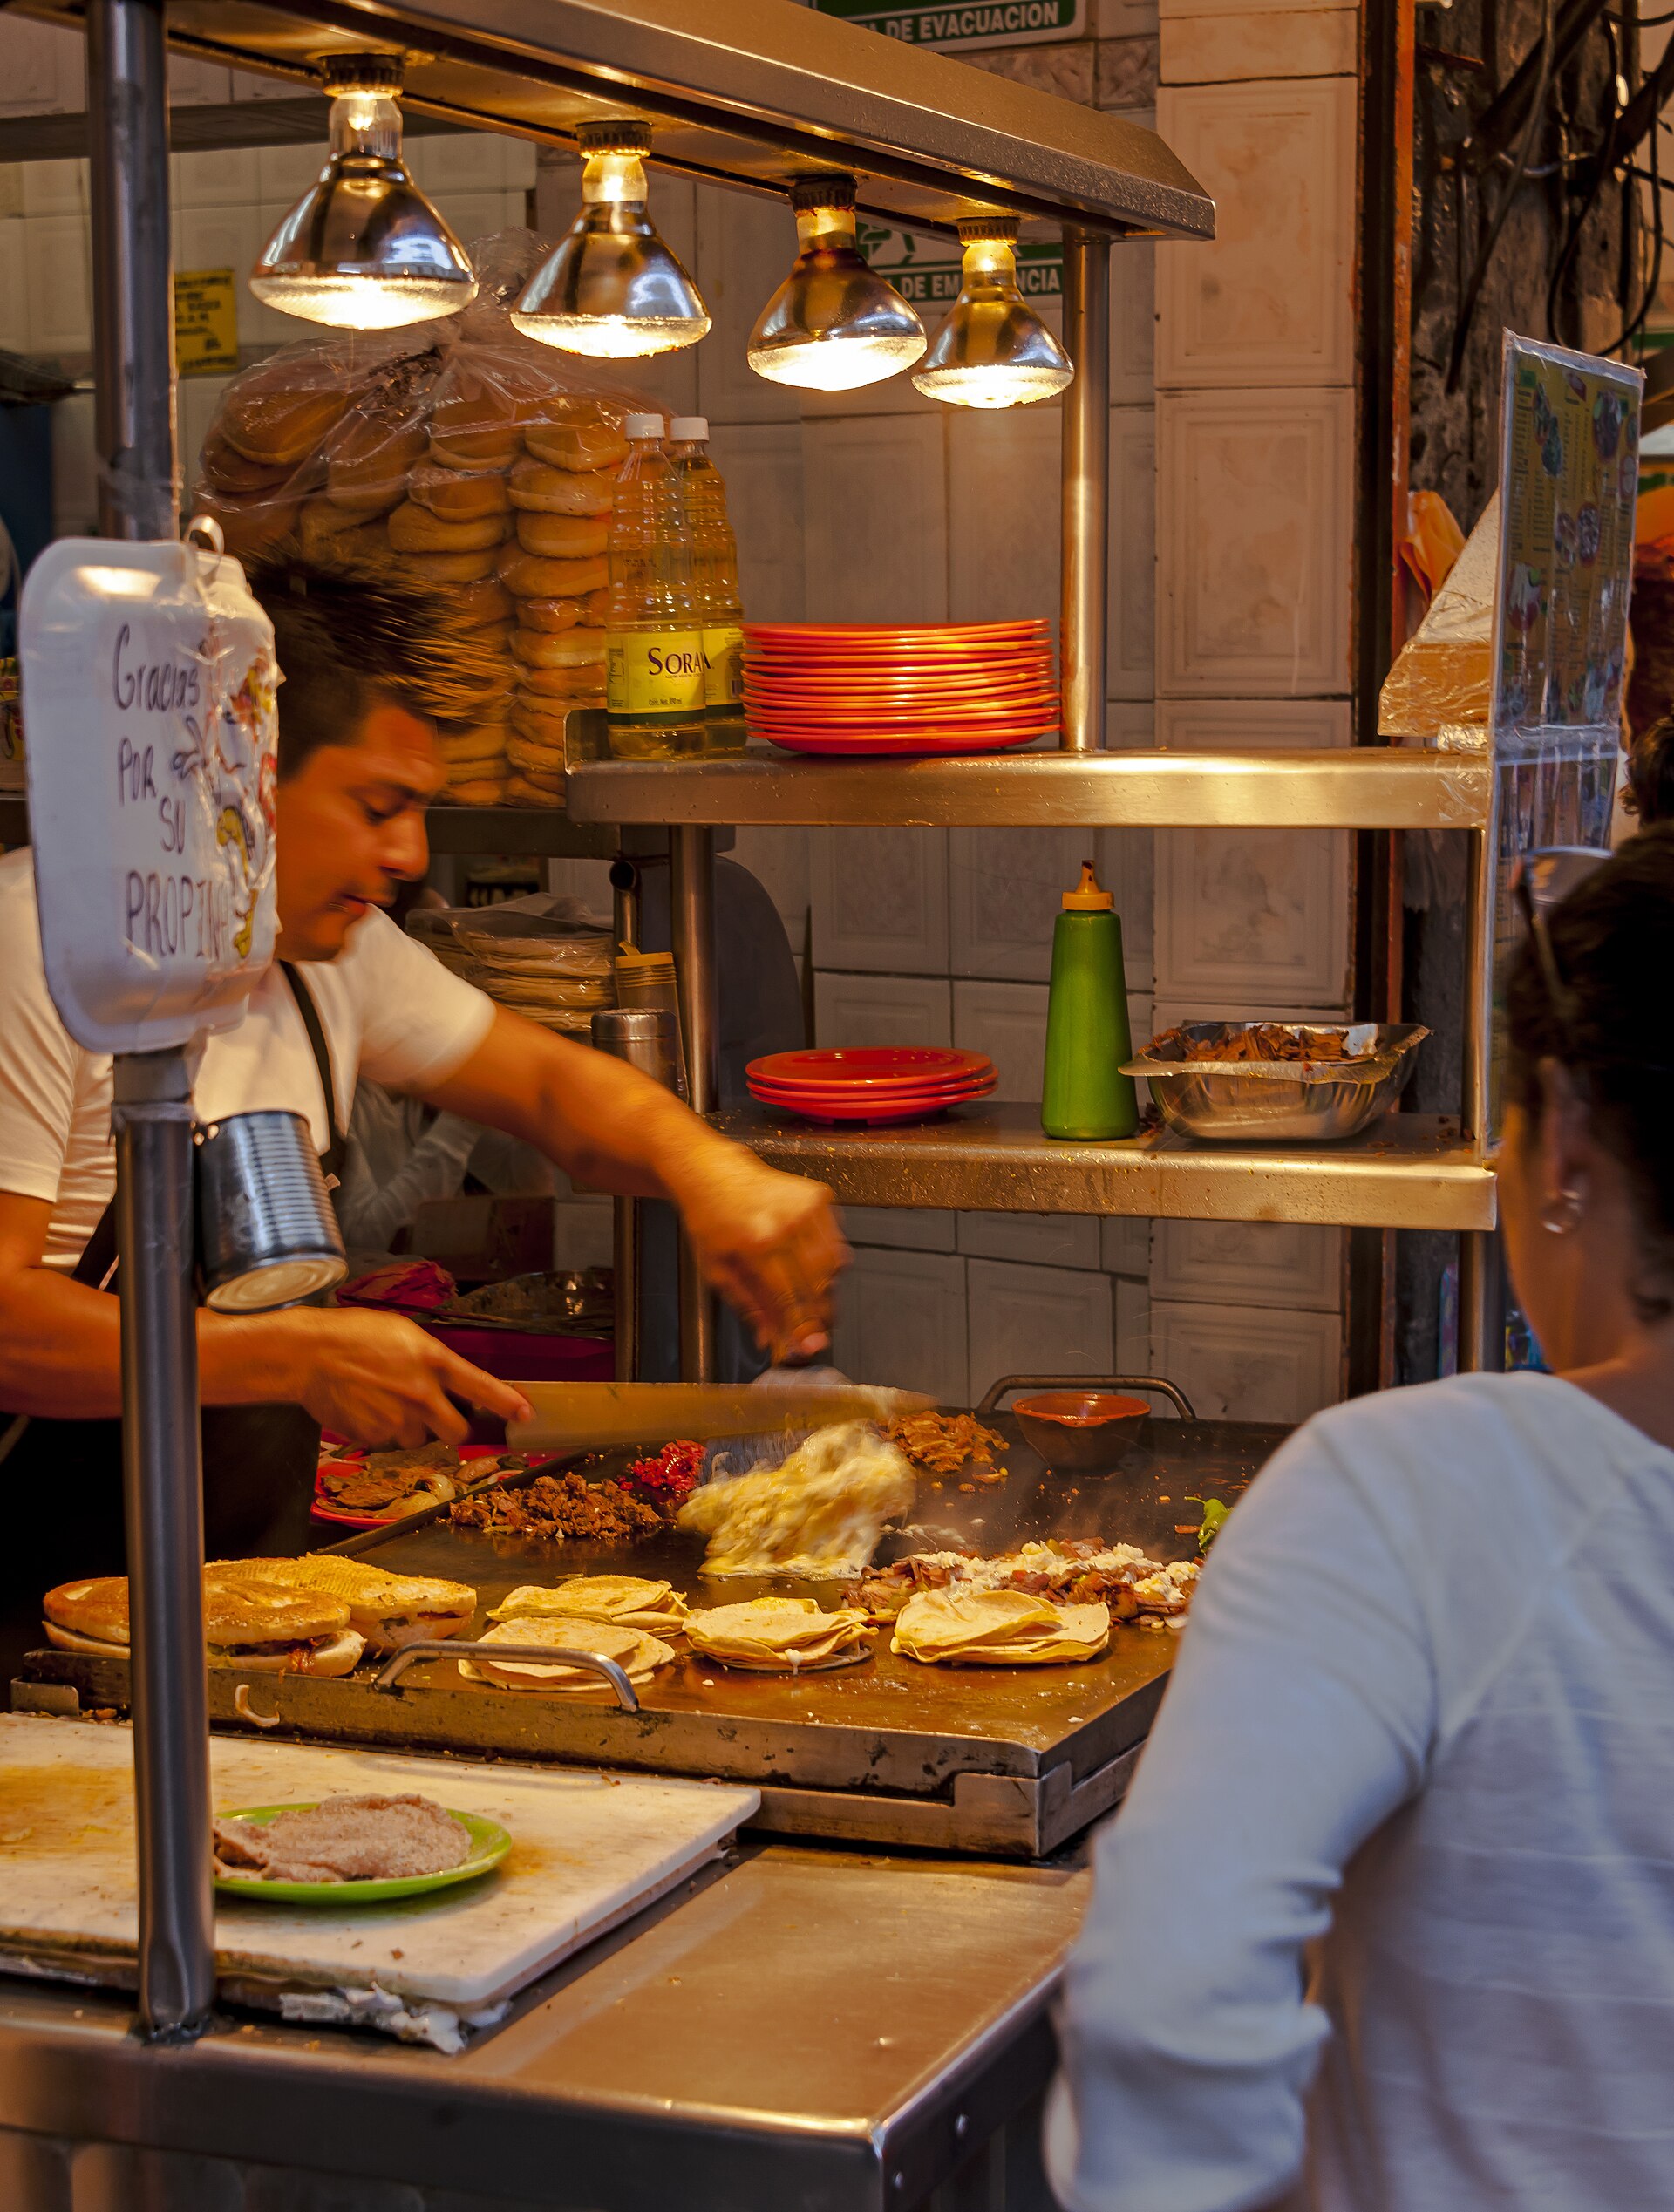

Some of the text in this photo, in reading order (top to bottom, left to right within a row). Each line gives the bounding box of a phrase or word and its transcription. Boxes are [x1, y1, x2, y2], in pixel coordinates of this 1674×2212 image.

[886, 1, 1058, 40] DE EVACUACION
[901, 267, 1060, 299] DE EMNCIA
[113, 623, 201, 712] Gracias
[159, 796, 186, 855] SU
